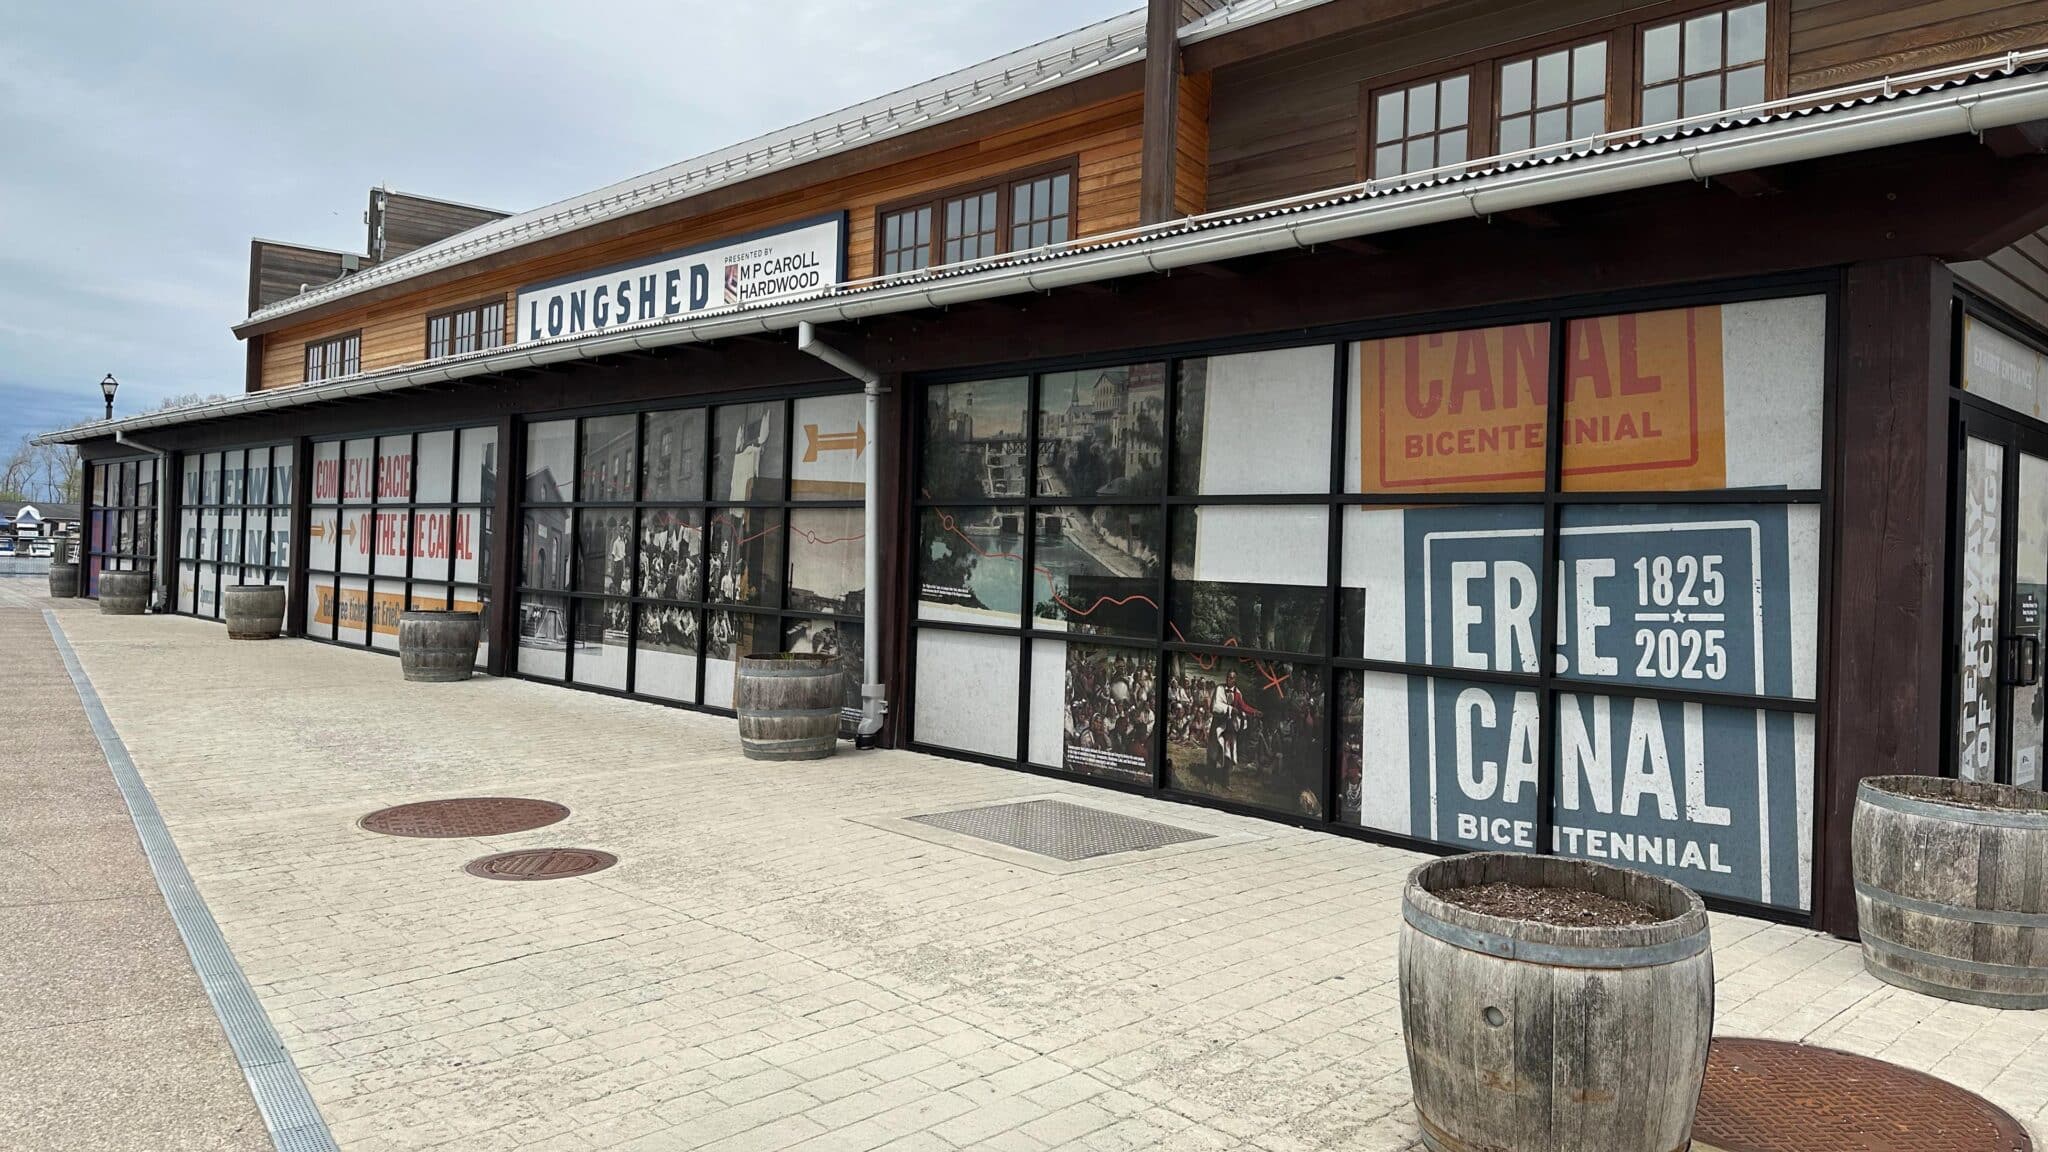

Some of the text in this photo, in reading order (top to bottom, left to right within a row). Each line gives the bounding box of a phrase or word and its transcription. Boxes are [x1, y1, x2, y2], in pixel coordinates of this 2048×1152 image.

[724, 247, 774, 263] PRESENTED BY
[764, 250, 819, 276] CAROLL
[530, 263, 710, 340] LONGSHED
[739, 270, 819, 299] HARDWOOD
[1405, 313, 1662, 419] CANAL
[1405, 411, 1662, 459] BICENTENIAL
[316, 457, 362, 499] COMLEX
[376, 513, 397, 556] THE
[400, 514, 426, 558] EIE
[1633, 555, 1724, 607] 1825
[1634, 628, 1727, 681] 2025
[1456, 687, 1731, 827] CANAL
